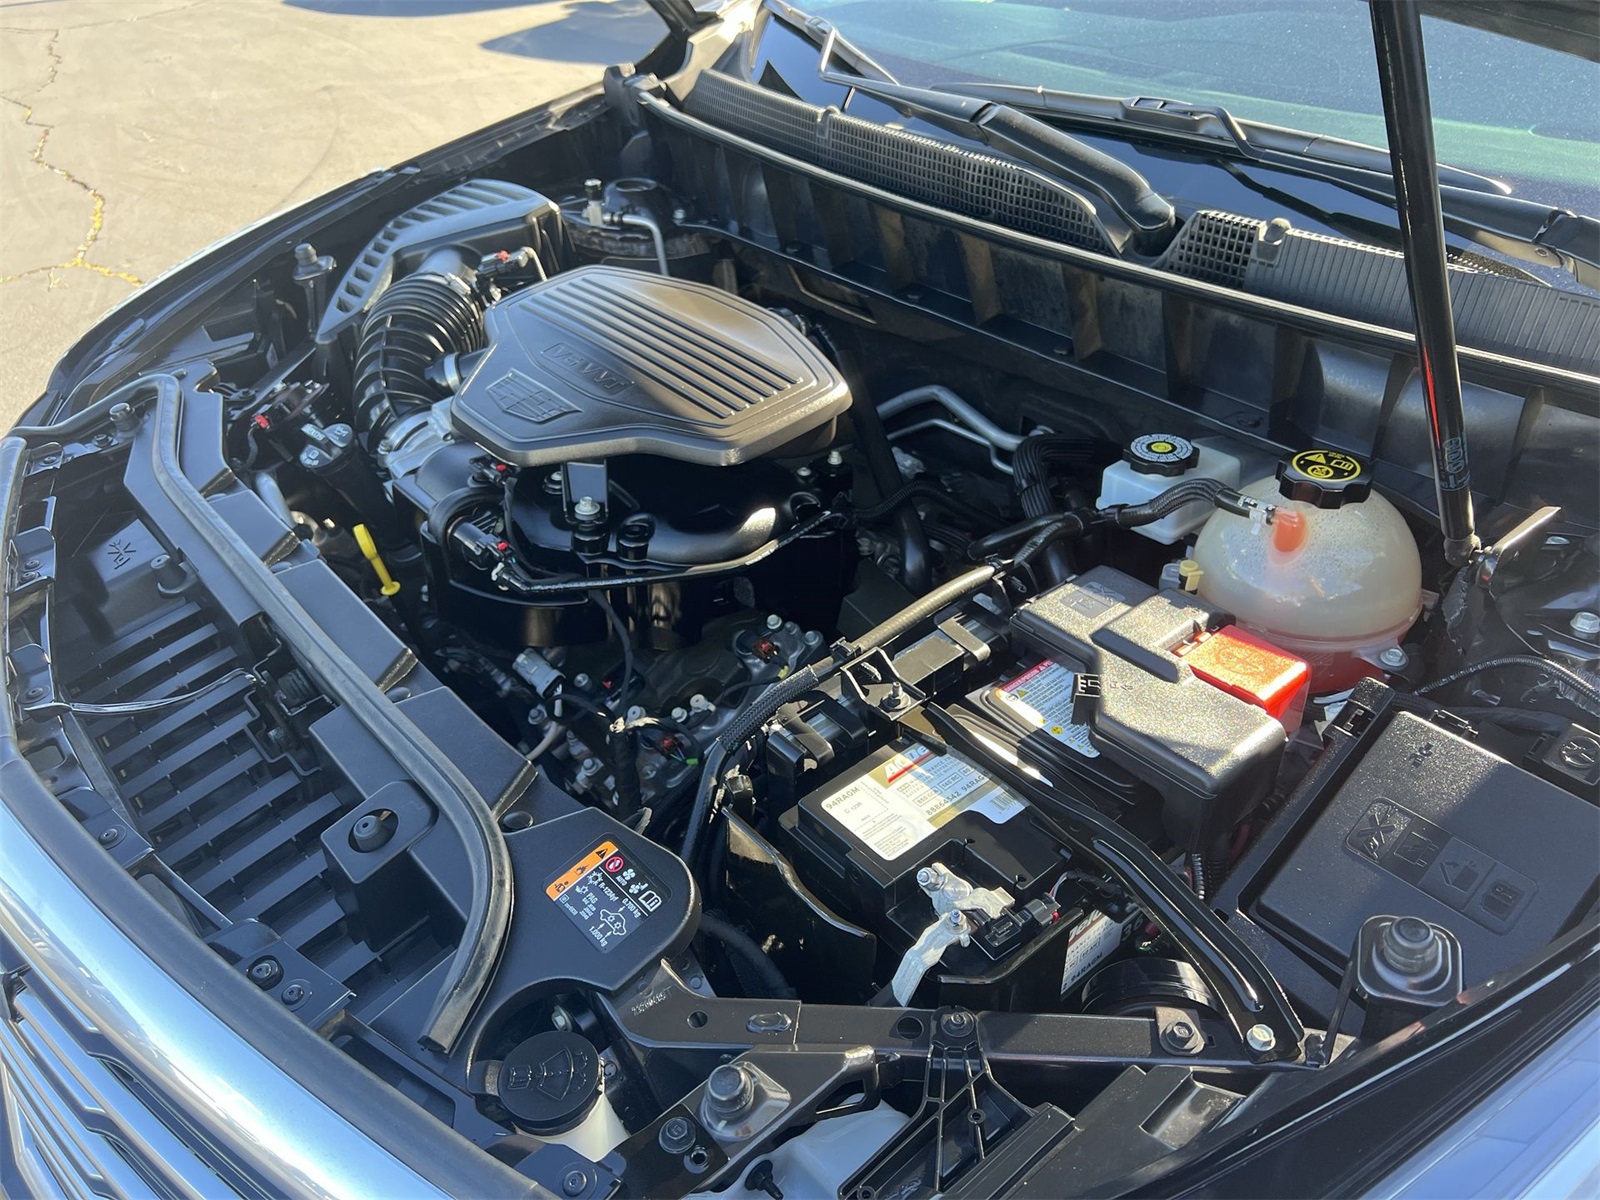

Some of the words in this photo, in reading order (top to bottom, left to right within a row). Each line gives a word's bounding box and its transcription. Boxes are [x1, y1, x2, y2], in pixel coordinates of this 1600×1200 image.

[824, 785, 860, 810] 94RAGM
[924, 790, 961, 816] 88864542
[585, 891, 598, 904] PAG
[631, 908, 642, 919] kg
[598, 936, 609, 948] kg
